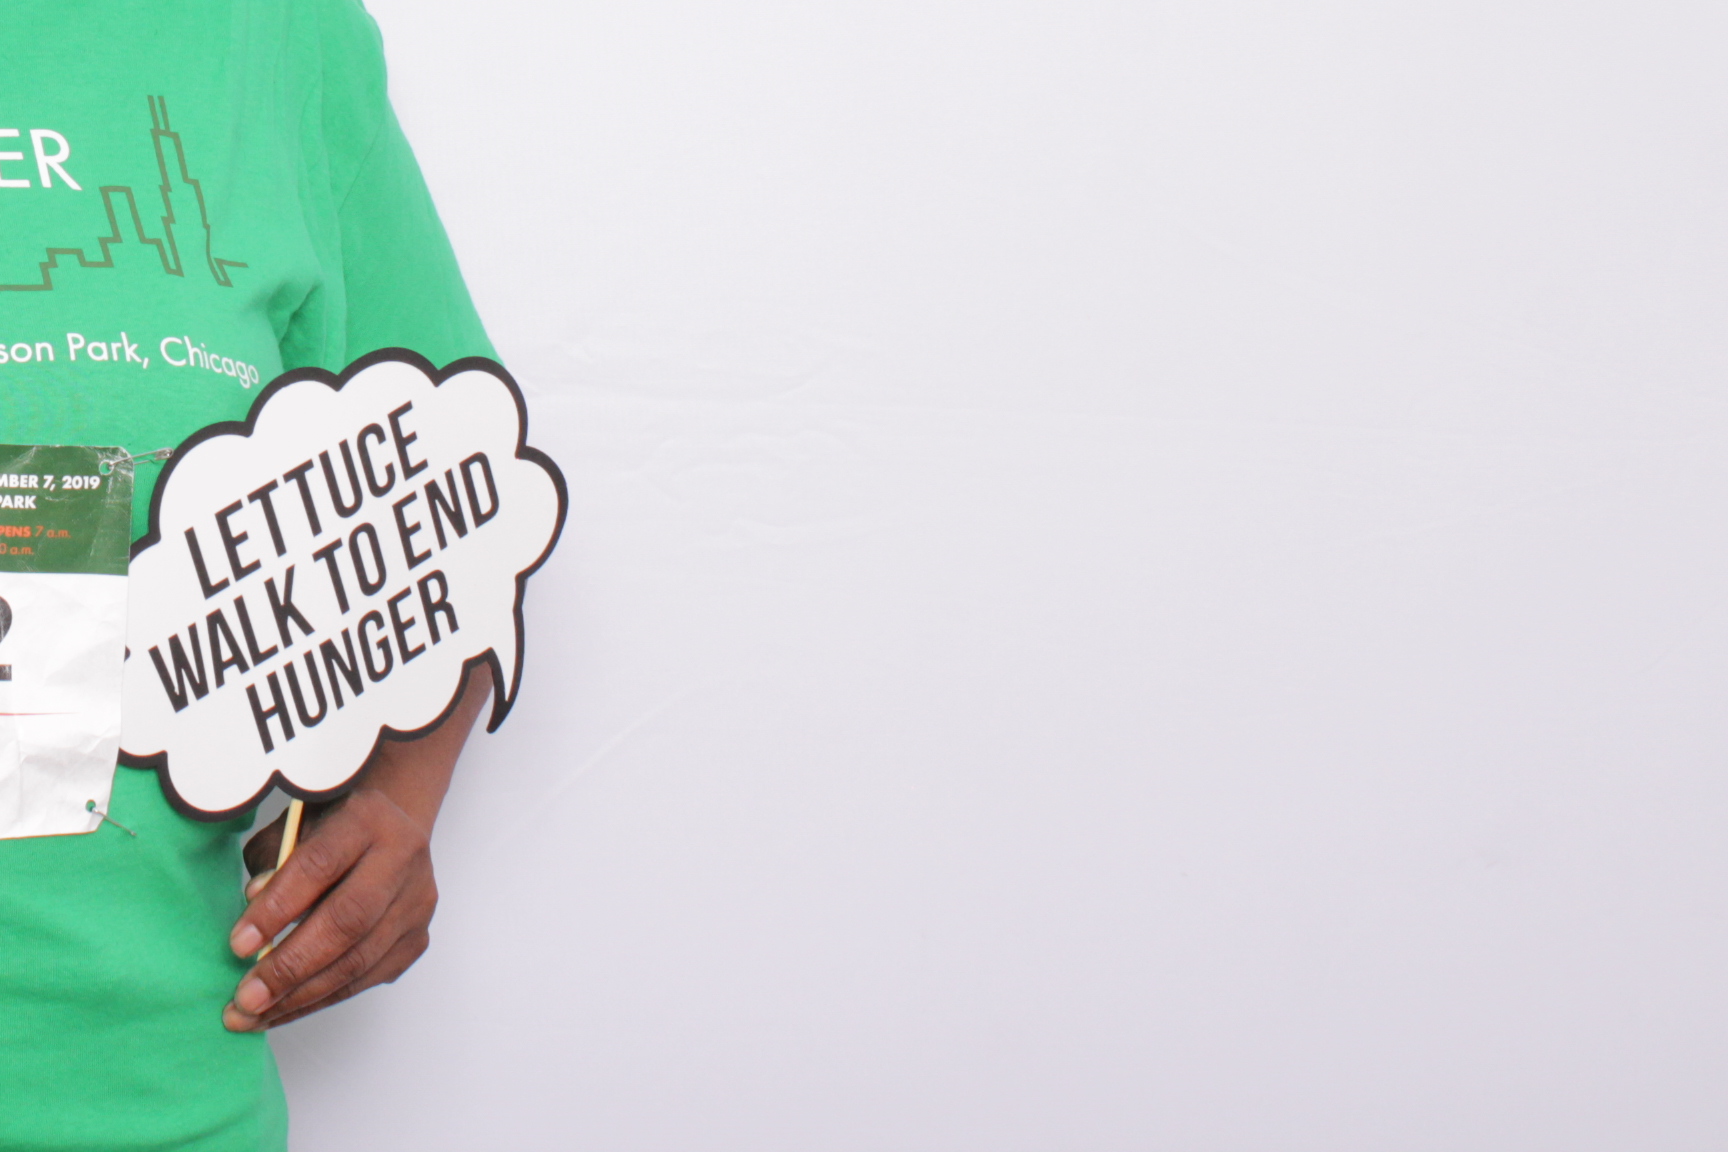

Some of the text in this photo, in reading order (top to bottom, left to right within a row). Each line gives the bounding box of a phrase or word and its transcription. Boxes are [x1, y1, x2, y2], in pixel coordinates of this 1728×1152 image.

[66, 331, 149, 369] Park,
[159, 335, 260, 389] Chicago
[42, 475, 57, 491] 7,
[61, 476, 101, 489] 2019
[184, 400, 429, 600] LETTUCE
[9, 545, 35, 555] a.m.
[35, 526, 44, 537] 7
[46, 528, 71, 538] a.m.
[148, 451, 500, 714] WALK TO END
[245, 569, 460, 755] HUNGER
